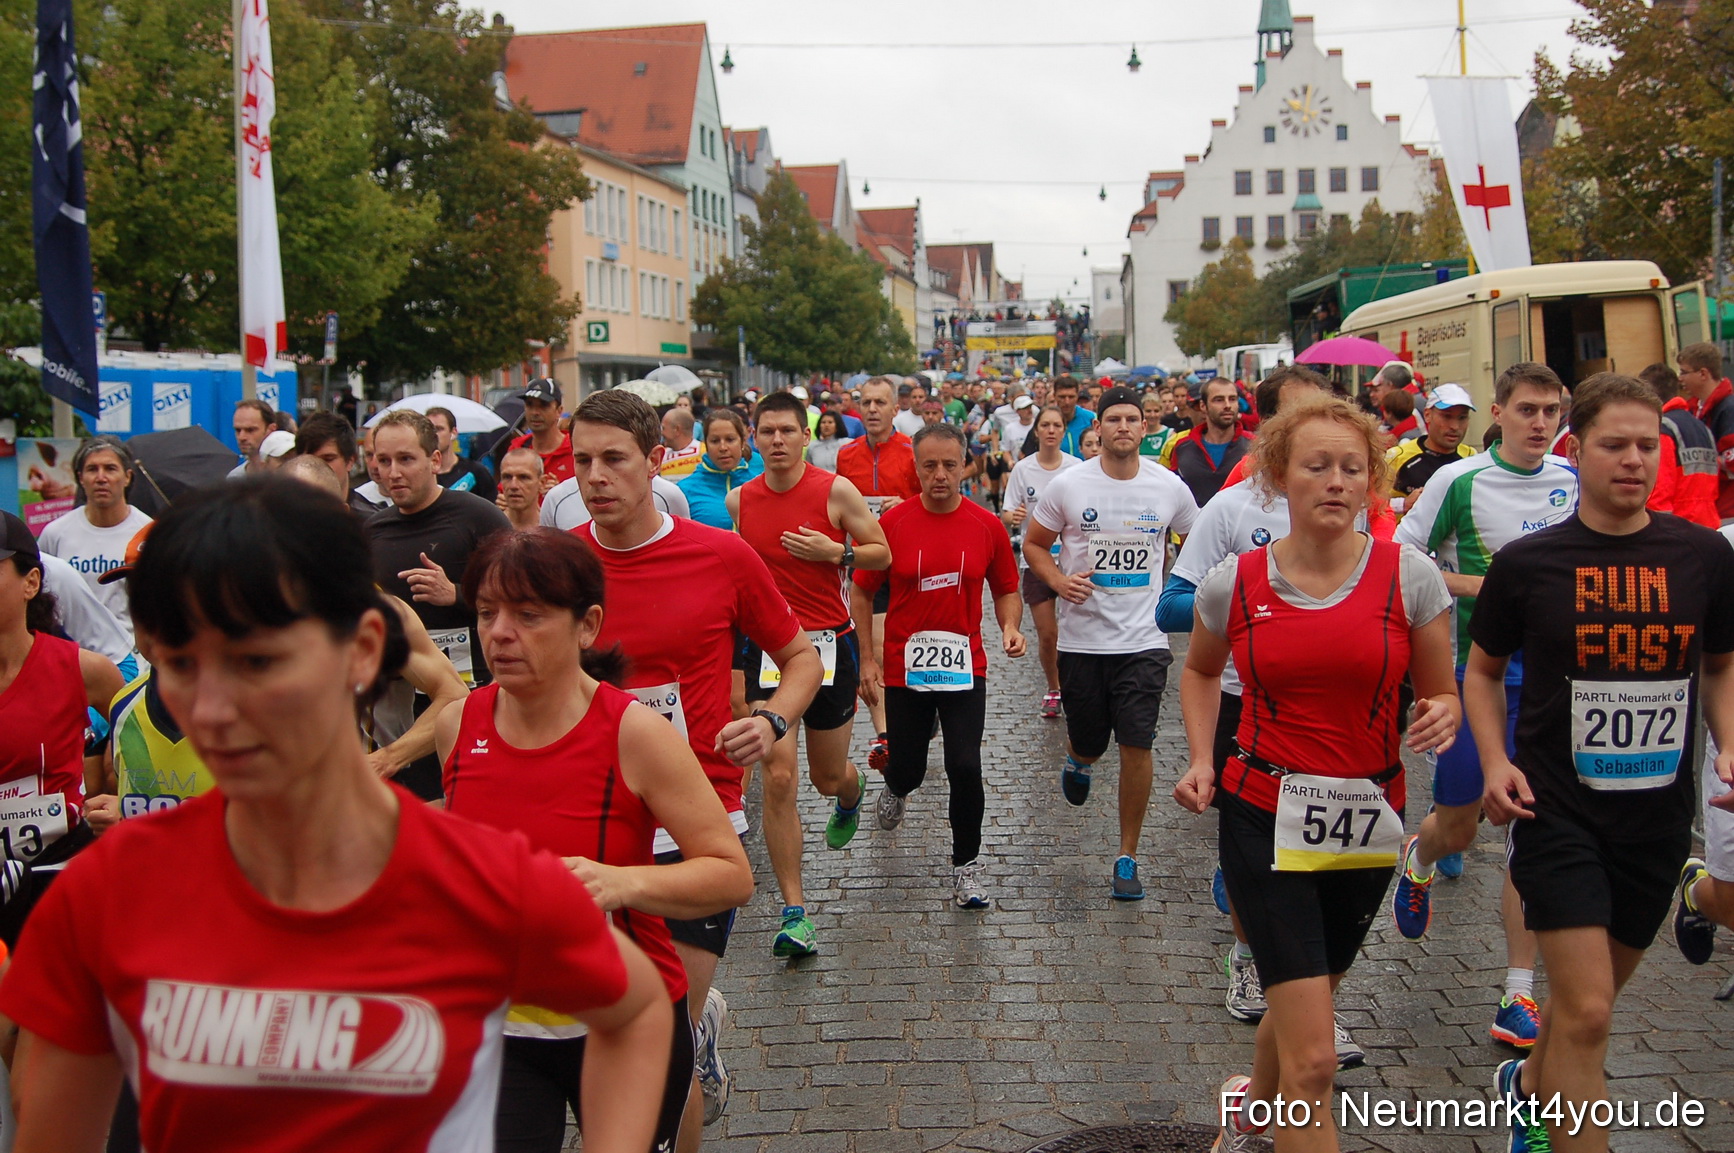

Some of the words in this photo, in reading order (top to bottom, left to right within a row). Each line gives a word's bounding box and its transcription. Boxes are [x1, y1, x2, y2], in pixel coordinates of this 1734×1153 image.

[589, 323, 607, 341] D
[153, 387, 190, 411] DIXI
[1080, 523, 1100, 531] PARTL
[1522, 518, 1548, 531] Axel
[1094, 549, 1149, 571] 2492
[931, 577, 948, 587] DEHN
[1110, 575, 1132, 586] Felix
[1575, 566, 1669, 613] RUN
[1254, 610, 1272, 618] erima
[930, 637, 960, 646] Neumarkt
[1575, 624, 1695, 672] FAST
[912, 646, 966, 670] 2284
[923, 673, 954, 683] Jochen
[1574, 692, 1616, 703] PARTL
[1618, 692, 1671, 703] Neumarkt
[1584, 707, 1677, 748] 2072
[1593, 758, 1666, 775] Sebastian
[123, 768, 197, 793] TEAM
[1282, 783, 1324, 800] PARTL
[1326, 789, 1383, 802] Neumarkt
[1302, 804, 1381, 848] 547
[261, 996, 292, 1065] COMPANY
